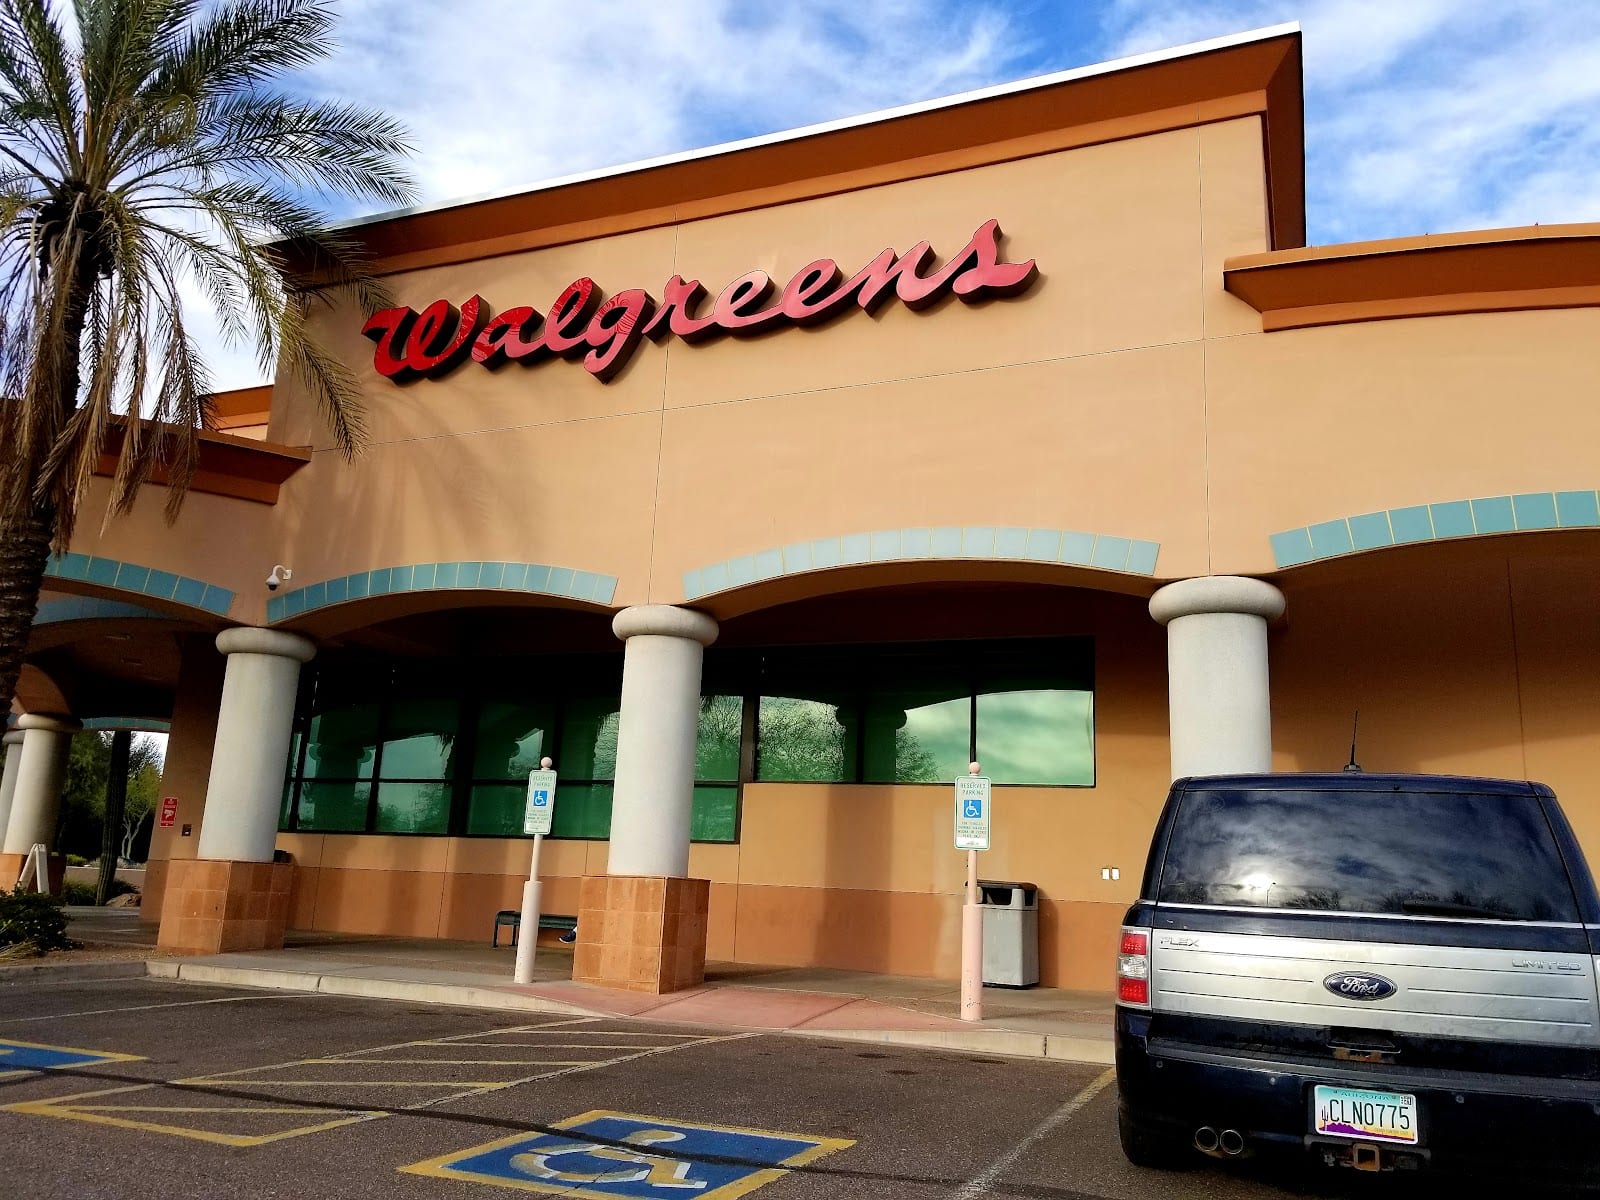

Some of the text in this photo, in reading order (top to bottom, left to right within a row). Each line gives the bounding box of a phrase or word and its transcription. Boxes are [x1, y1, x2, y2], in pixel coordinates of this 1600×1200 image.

[362, 219, 1037, 384] Walgreens
[1160, 936, 1200, 947] FLEX
[1512, 959, 1581, 971] LIMITED
[1340, 976, 1379, 994] Ford
[1329, 1099, 1410, 1130] CLN0775
